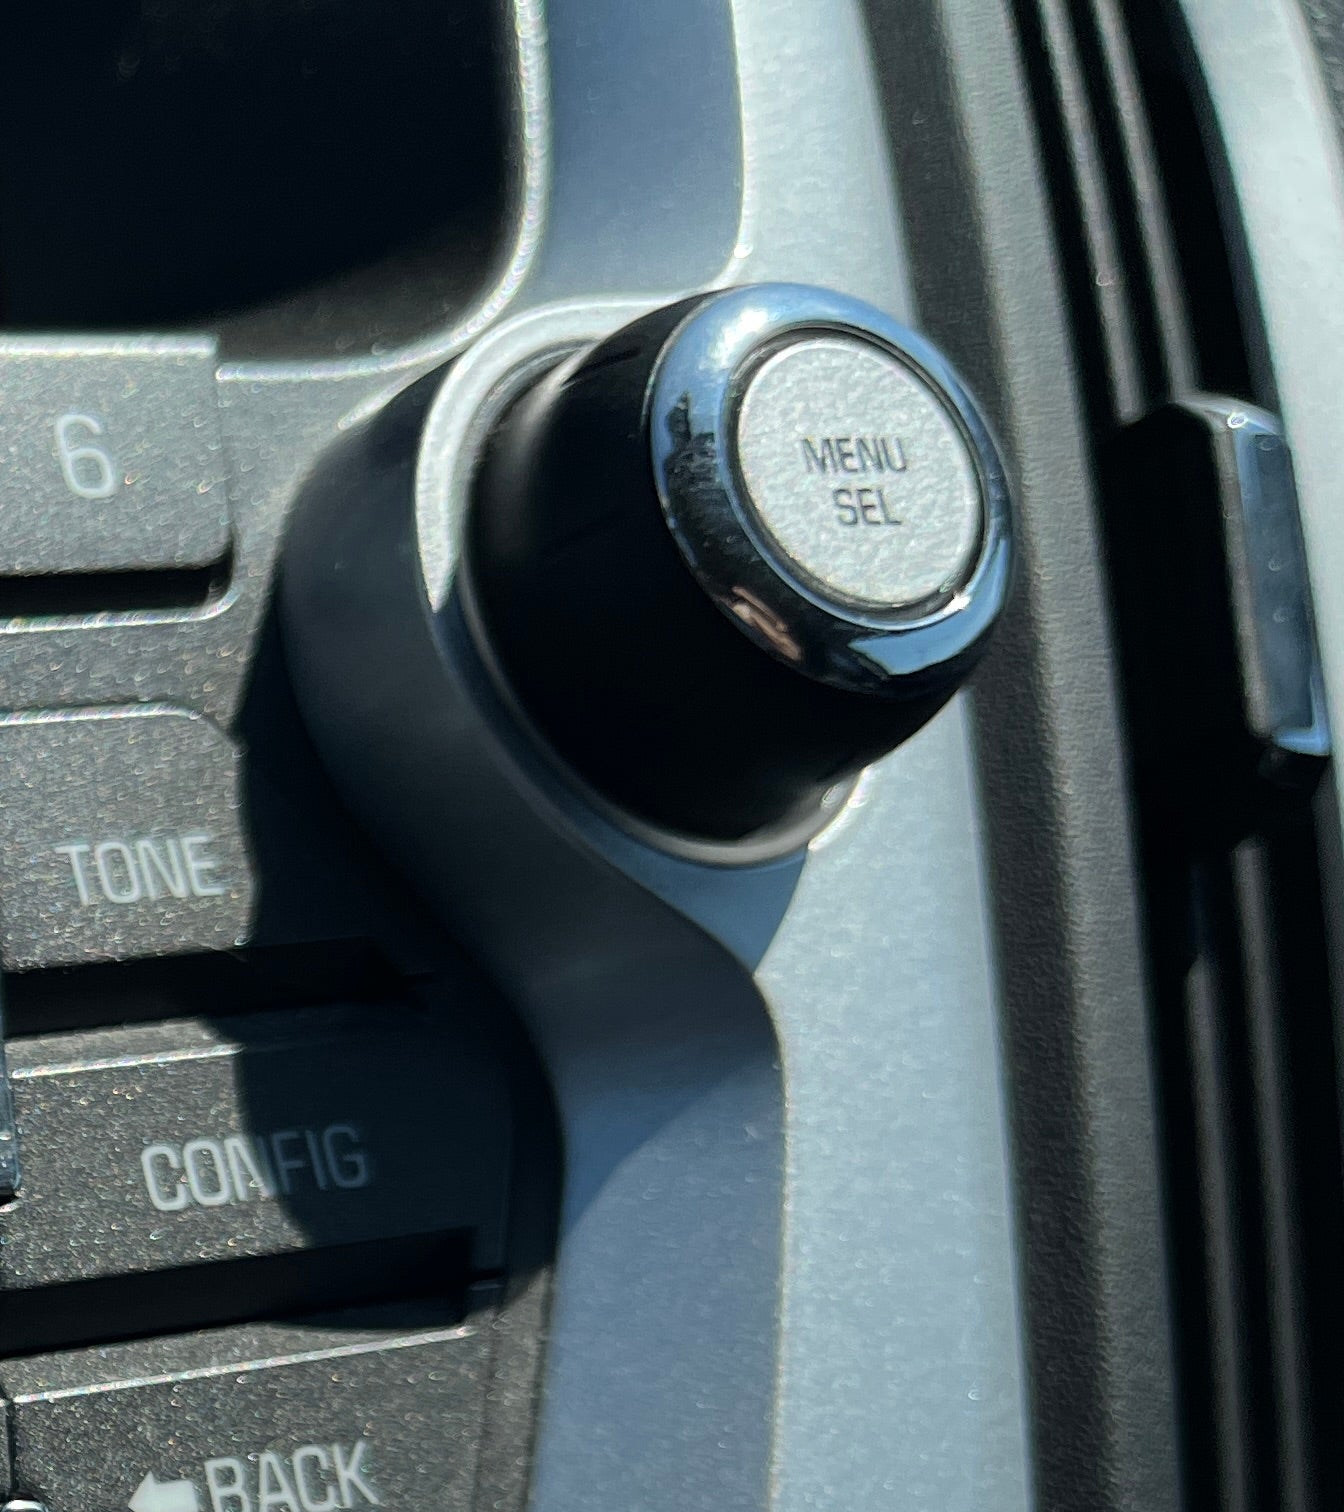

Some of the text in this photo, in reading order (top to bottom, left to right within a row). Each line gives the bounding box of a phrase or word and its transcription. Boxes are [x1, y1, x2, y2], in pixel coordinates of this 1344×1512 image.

[54, 413, 114, 499] 6
[799, 436, 908, 474] MENU
[832, 488, 902, 526] SEL
[55, 835, 227, 907] TONE
[141, 1123, 372, 1213] CONFIG
